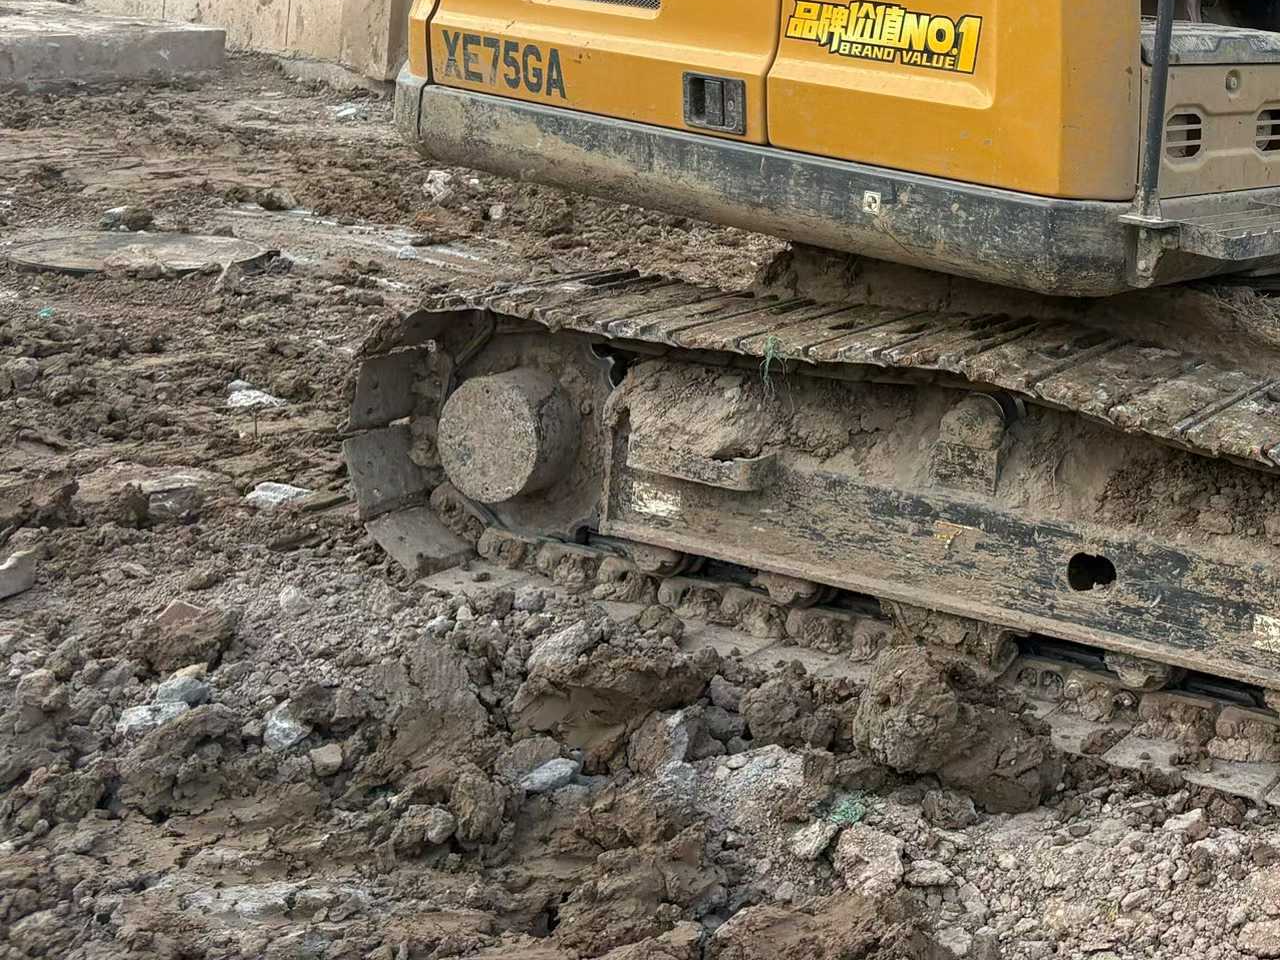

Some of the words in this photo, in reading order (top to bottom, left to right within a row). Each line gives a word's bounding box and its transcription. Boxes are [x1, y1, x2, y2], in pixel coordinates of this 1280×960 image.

[441, 29, 567, 99] XE75GA
[839, 43, 895, 61] BRAND
[902, 50, 956, 69] VALUE
